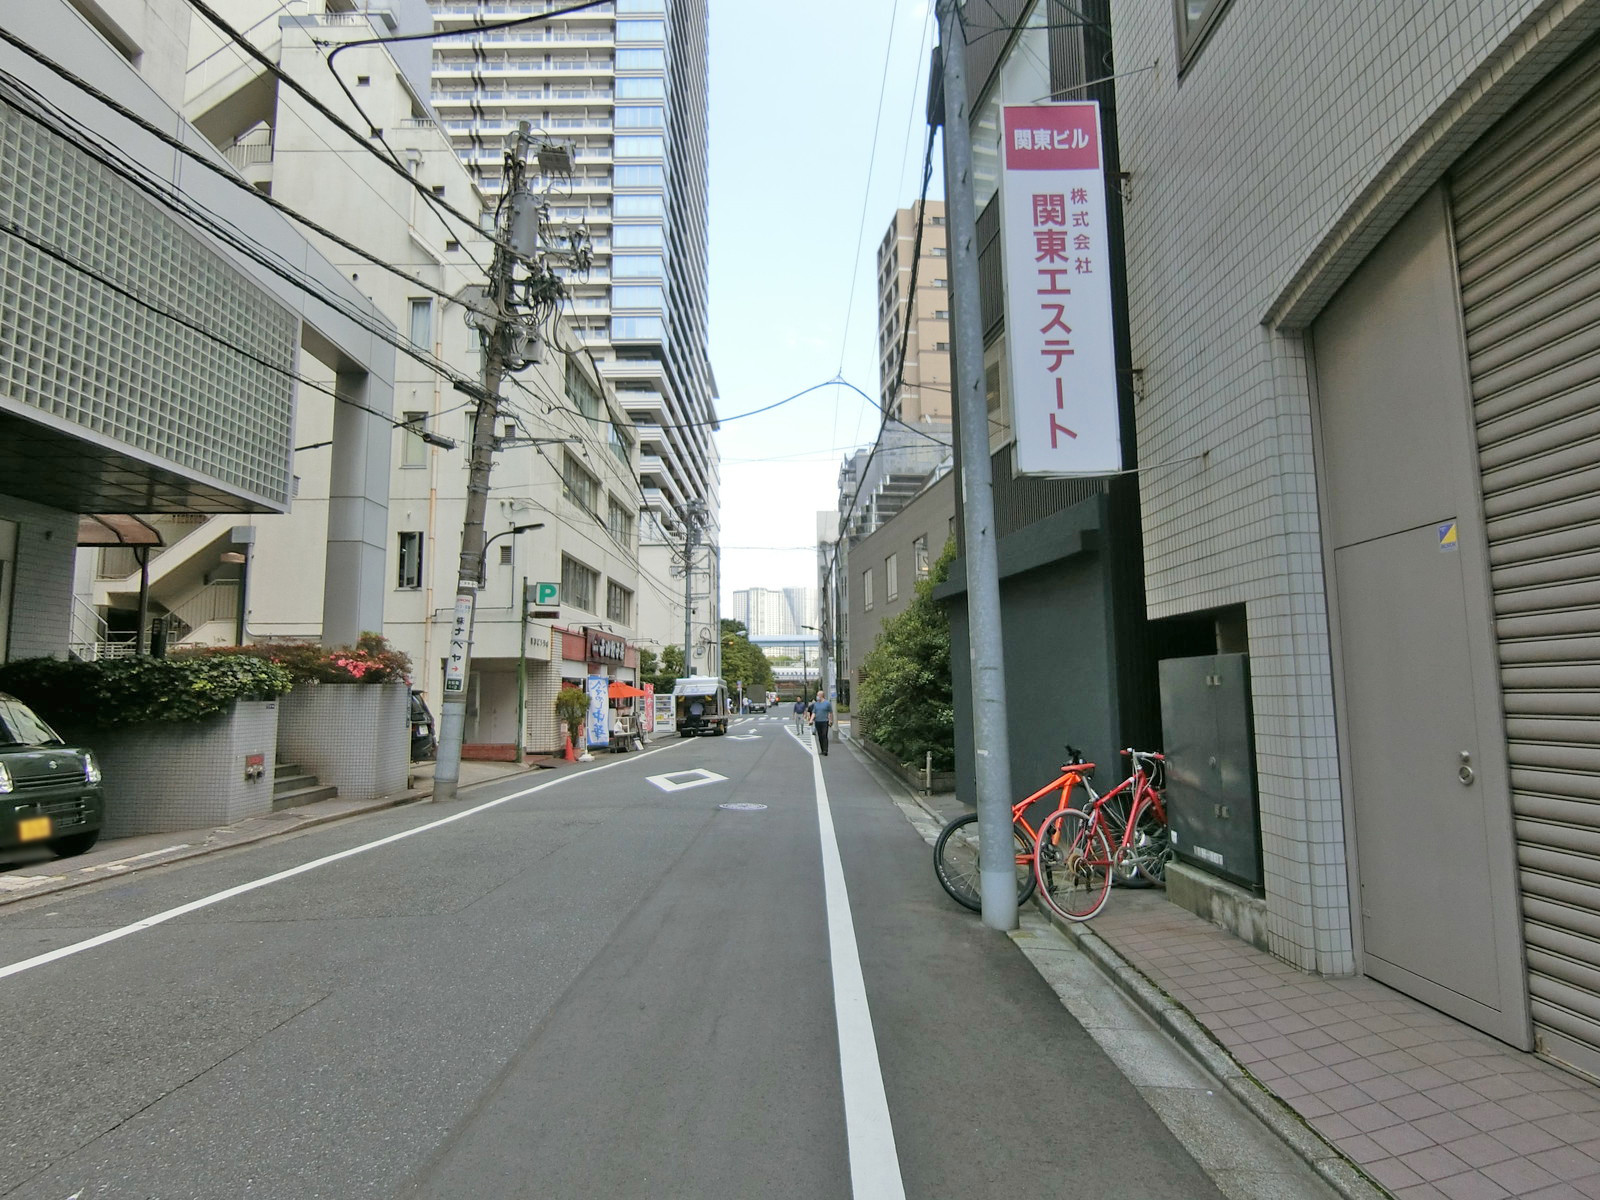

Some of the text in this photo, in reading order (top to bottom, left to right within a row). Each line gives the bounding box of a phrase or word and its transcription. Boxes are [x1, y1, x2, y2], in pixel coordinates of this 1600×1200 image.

[1014, 128, 1088, 151] 関東ビル
[1071, 188, 1092, 274] 株式会社
[1032, 194, 1077, 449] 関東エステート
[539, 584, 556, 603] P
